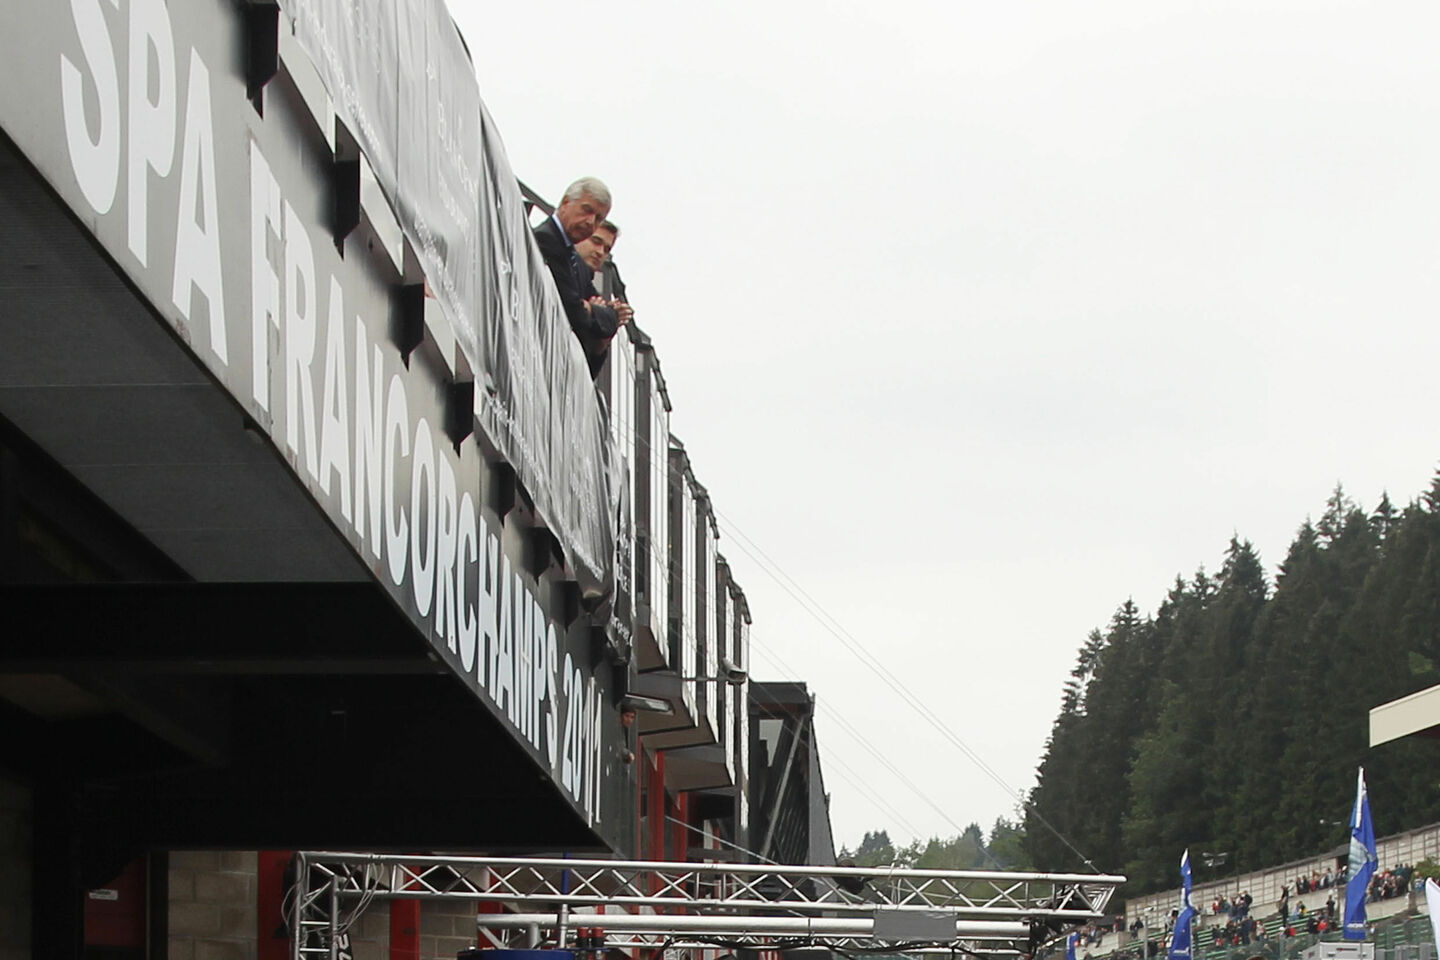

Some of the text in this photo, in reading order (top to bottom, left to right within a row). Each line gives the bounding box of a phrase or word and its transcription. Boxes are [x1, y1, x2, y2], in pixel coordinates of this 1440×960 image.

[61, 0, 228, 366] SPA
[251, 139, 558, 770] FRANCORCHAMPS
[563, 652, 604, 826] 2011
